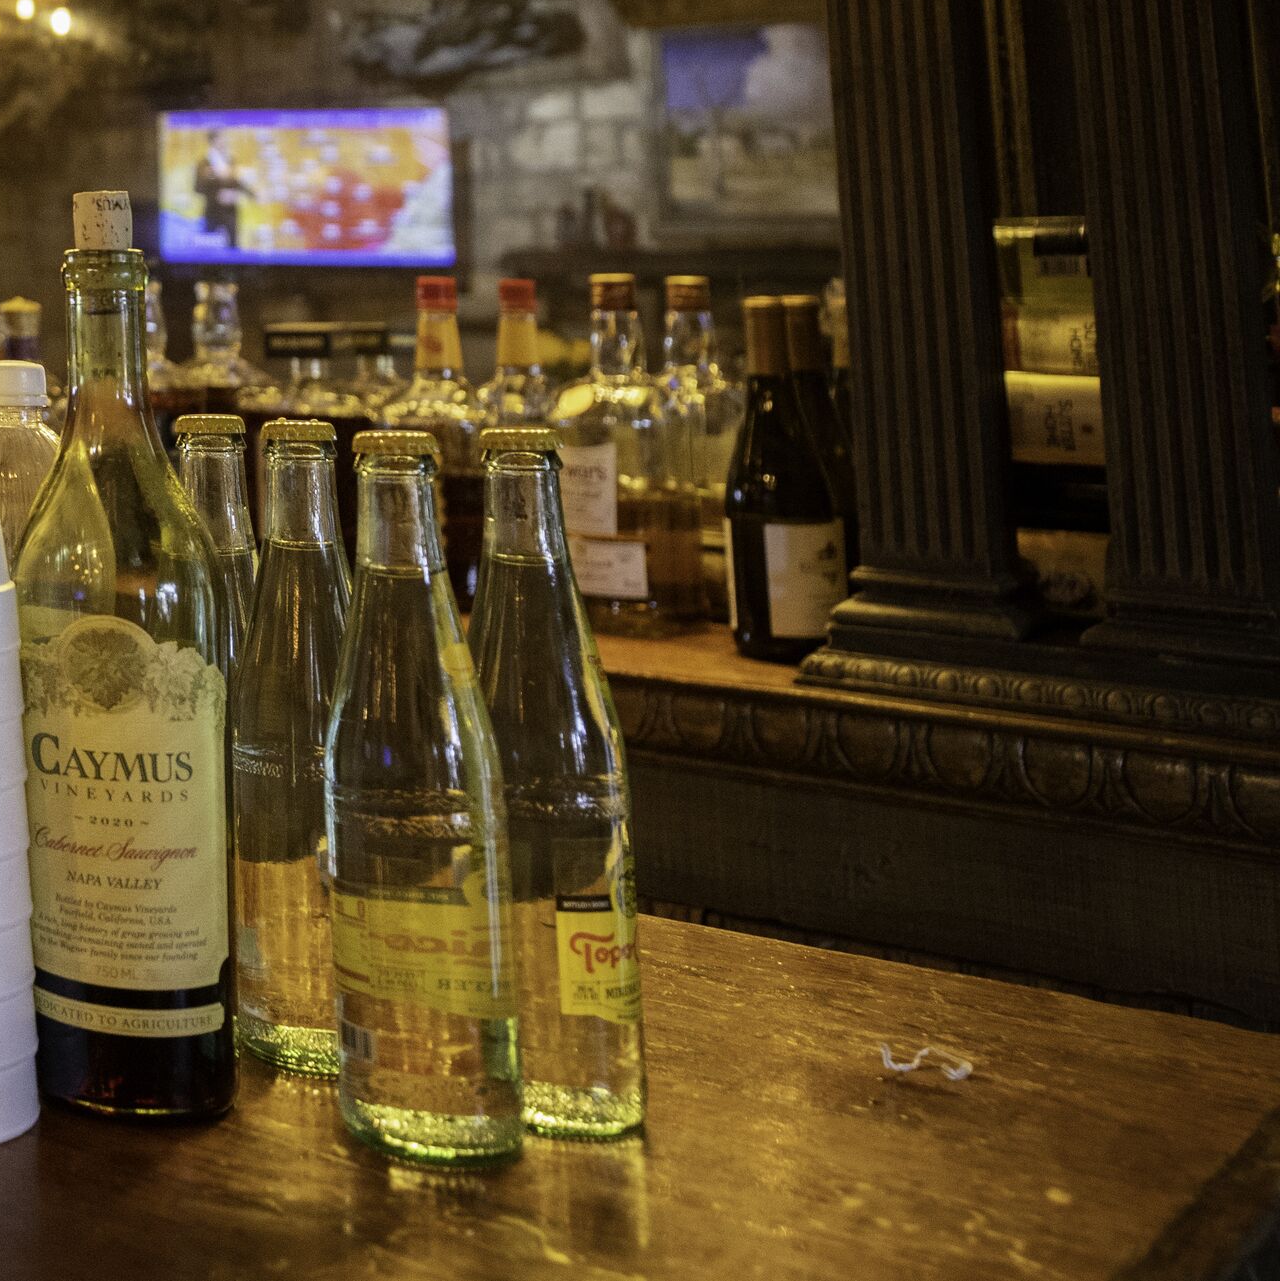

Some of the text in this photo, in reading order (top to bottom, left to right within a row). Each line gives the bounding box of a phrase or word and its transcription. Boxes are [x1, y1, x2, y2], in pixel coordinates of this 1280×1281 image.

[31, 732, 193, 784] CAYMUS
[40, 779, 189, 803] VINEYARDS
[89, 815, 134, 828] 2020
[35, 826, 198, 872] Cabernet Sauvignon
[67, 870, 164, 891] NAPA VALLEY
[96, 900, 132, 913] Caymus
[134, 903, 178, 915] Vineyards
[99, 1014, 117, 1026] TO
[121, 1016, 214, 1032] AGRICULTURE
